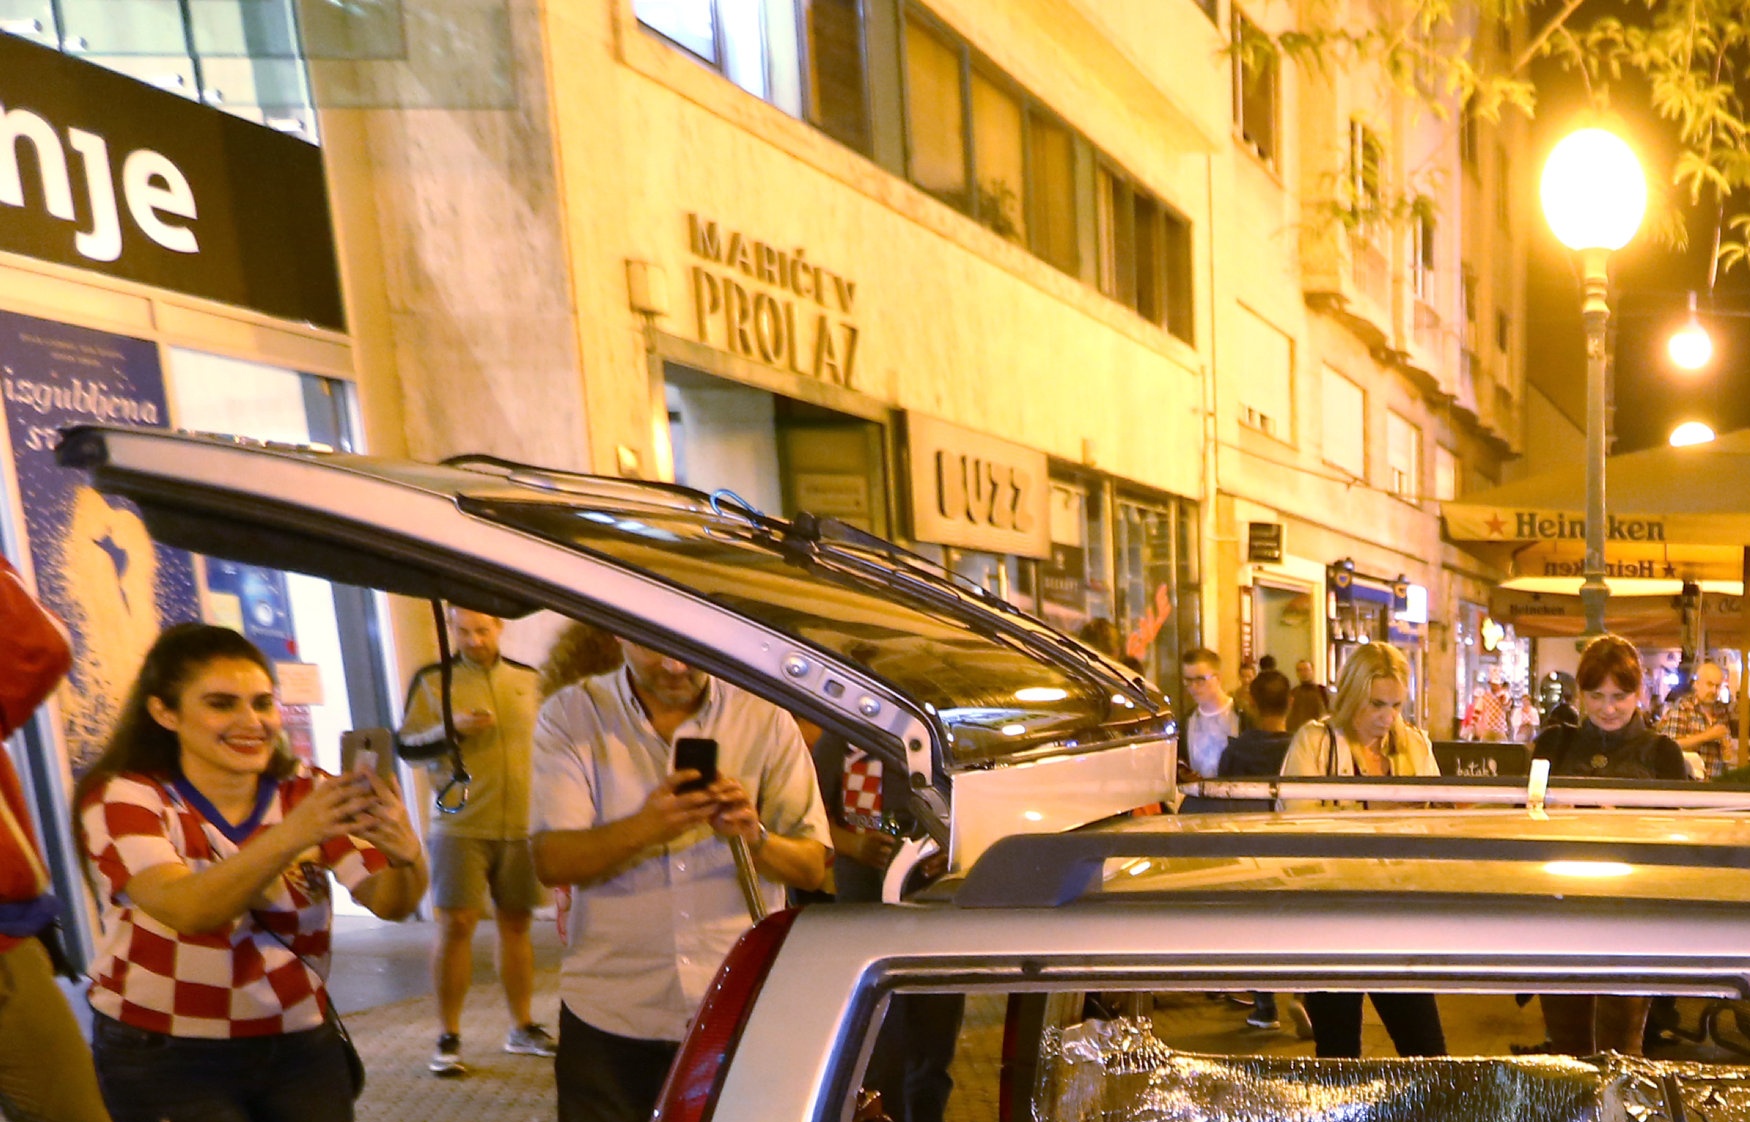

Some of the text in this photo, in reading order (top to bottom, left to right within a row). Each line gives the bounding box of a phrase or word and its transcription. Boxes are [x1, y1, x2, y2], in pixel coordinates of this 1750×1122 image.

[691, 266, 859, 390] PROLAZ
[4, 366, 159, 424] izgubljena
[1515, 511, 1666, 541] Heinken
[1509, 603, 1566, 616] Heineken
